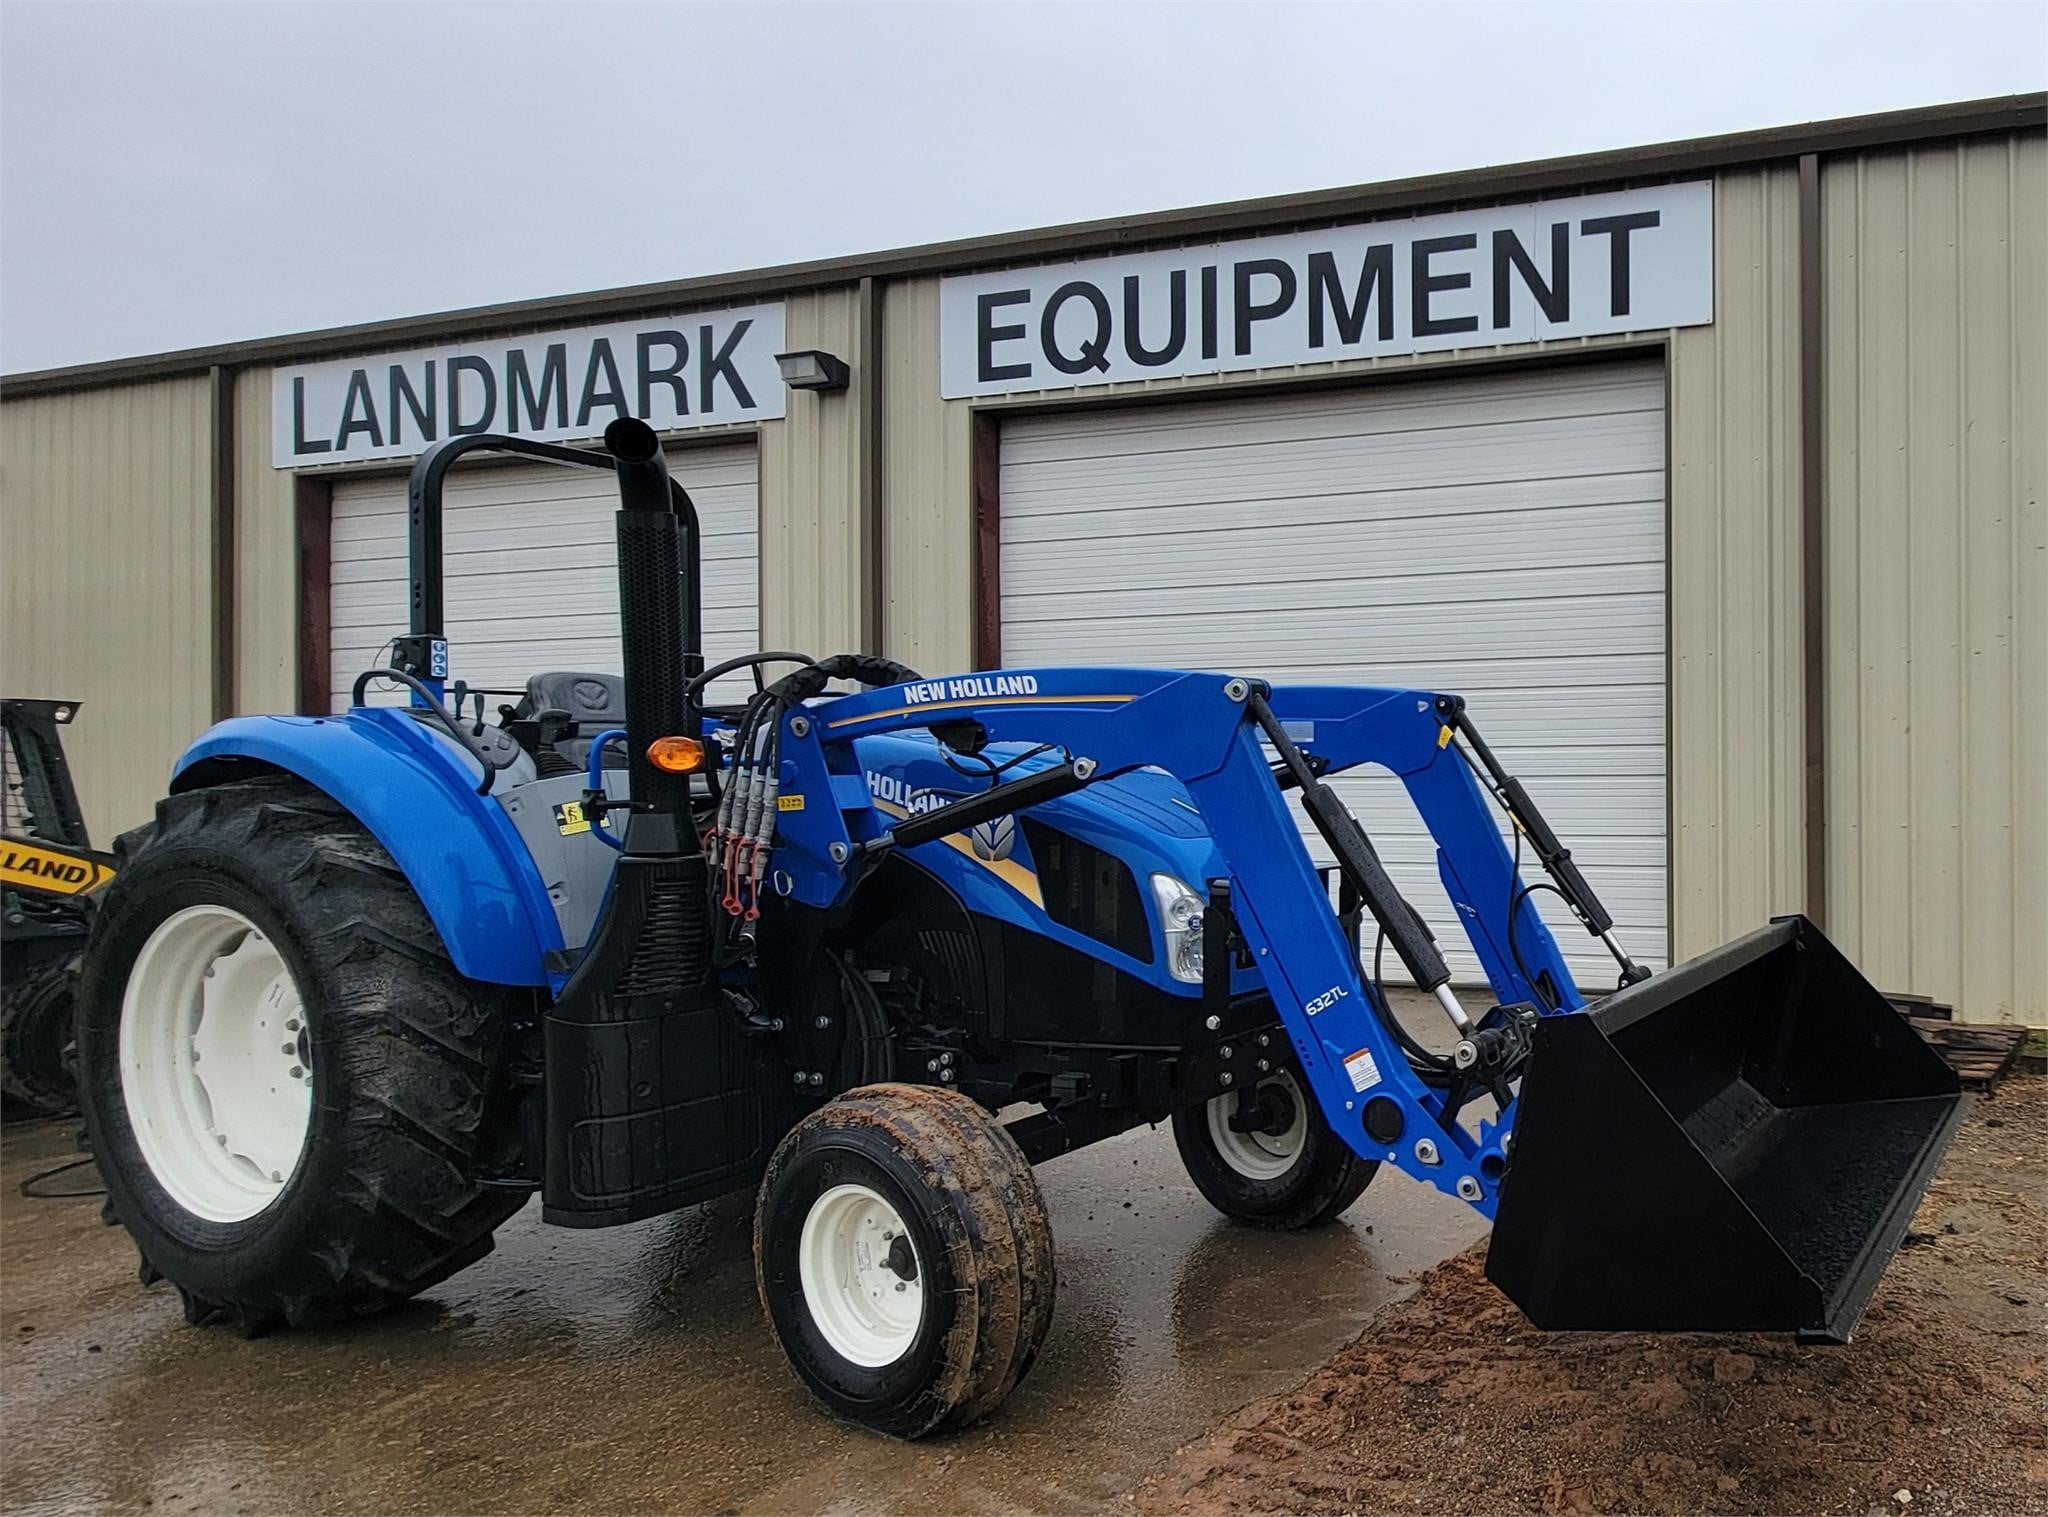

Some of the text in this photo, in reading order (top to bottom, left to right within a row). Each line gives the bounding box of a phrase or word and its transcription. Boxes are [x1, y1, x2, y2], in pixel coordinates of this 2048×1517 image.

[293, 210, 1661, 456] LANDMARK EQUIPMENT
[904, 675, 1038, 704] NEW HOLLAND
[866, 770, 953, 814] HOLLAN
[0, 852, 87, 884] LAND
[1305, 985, 1349, 1016] 632TL
